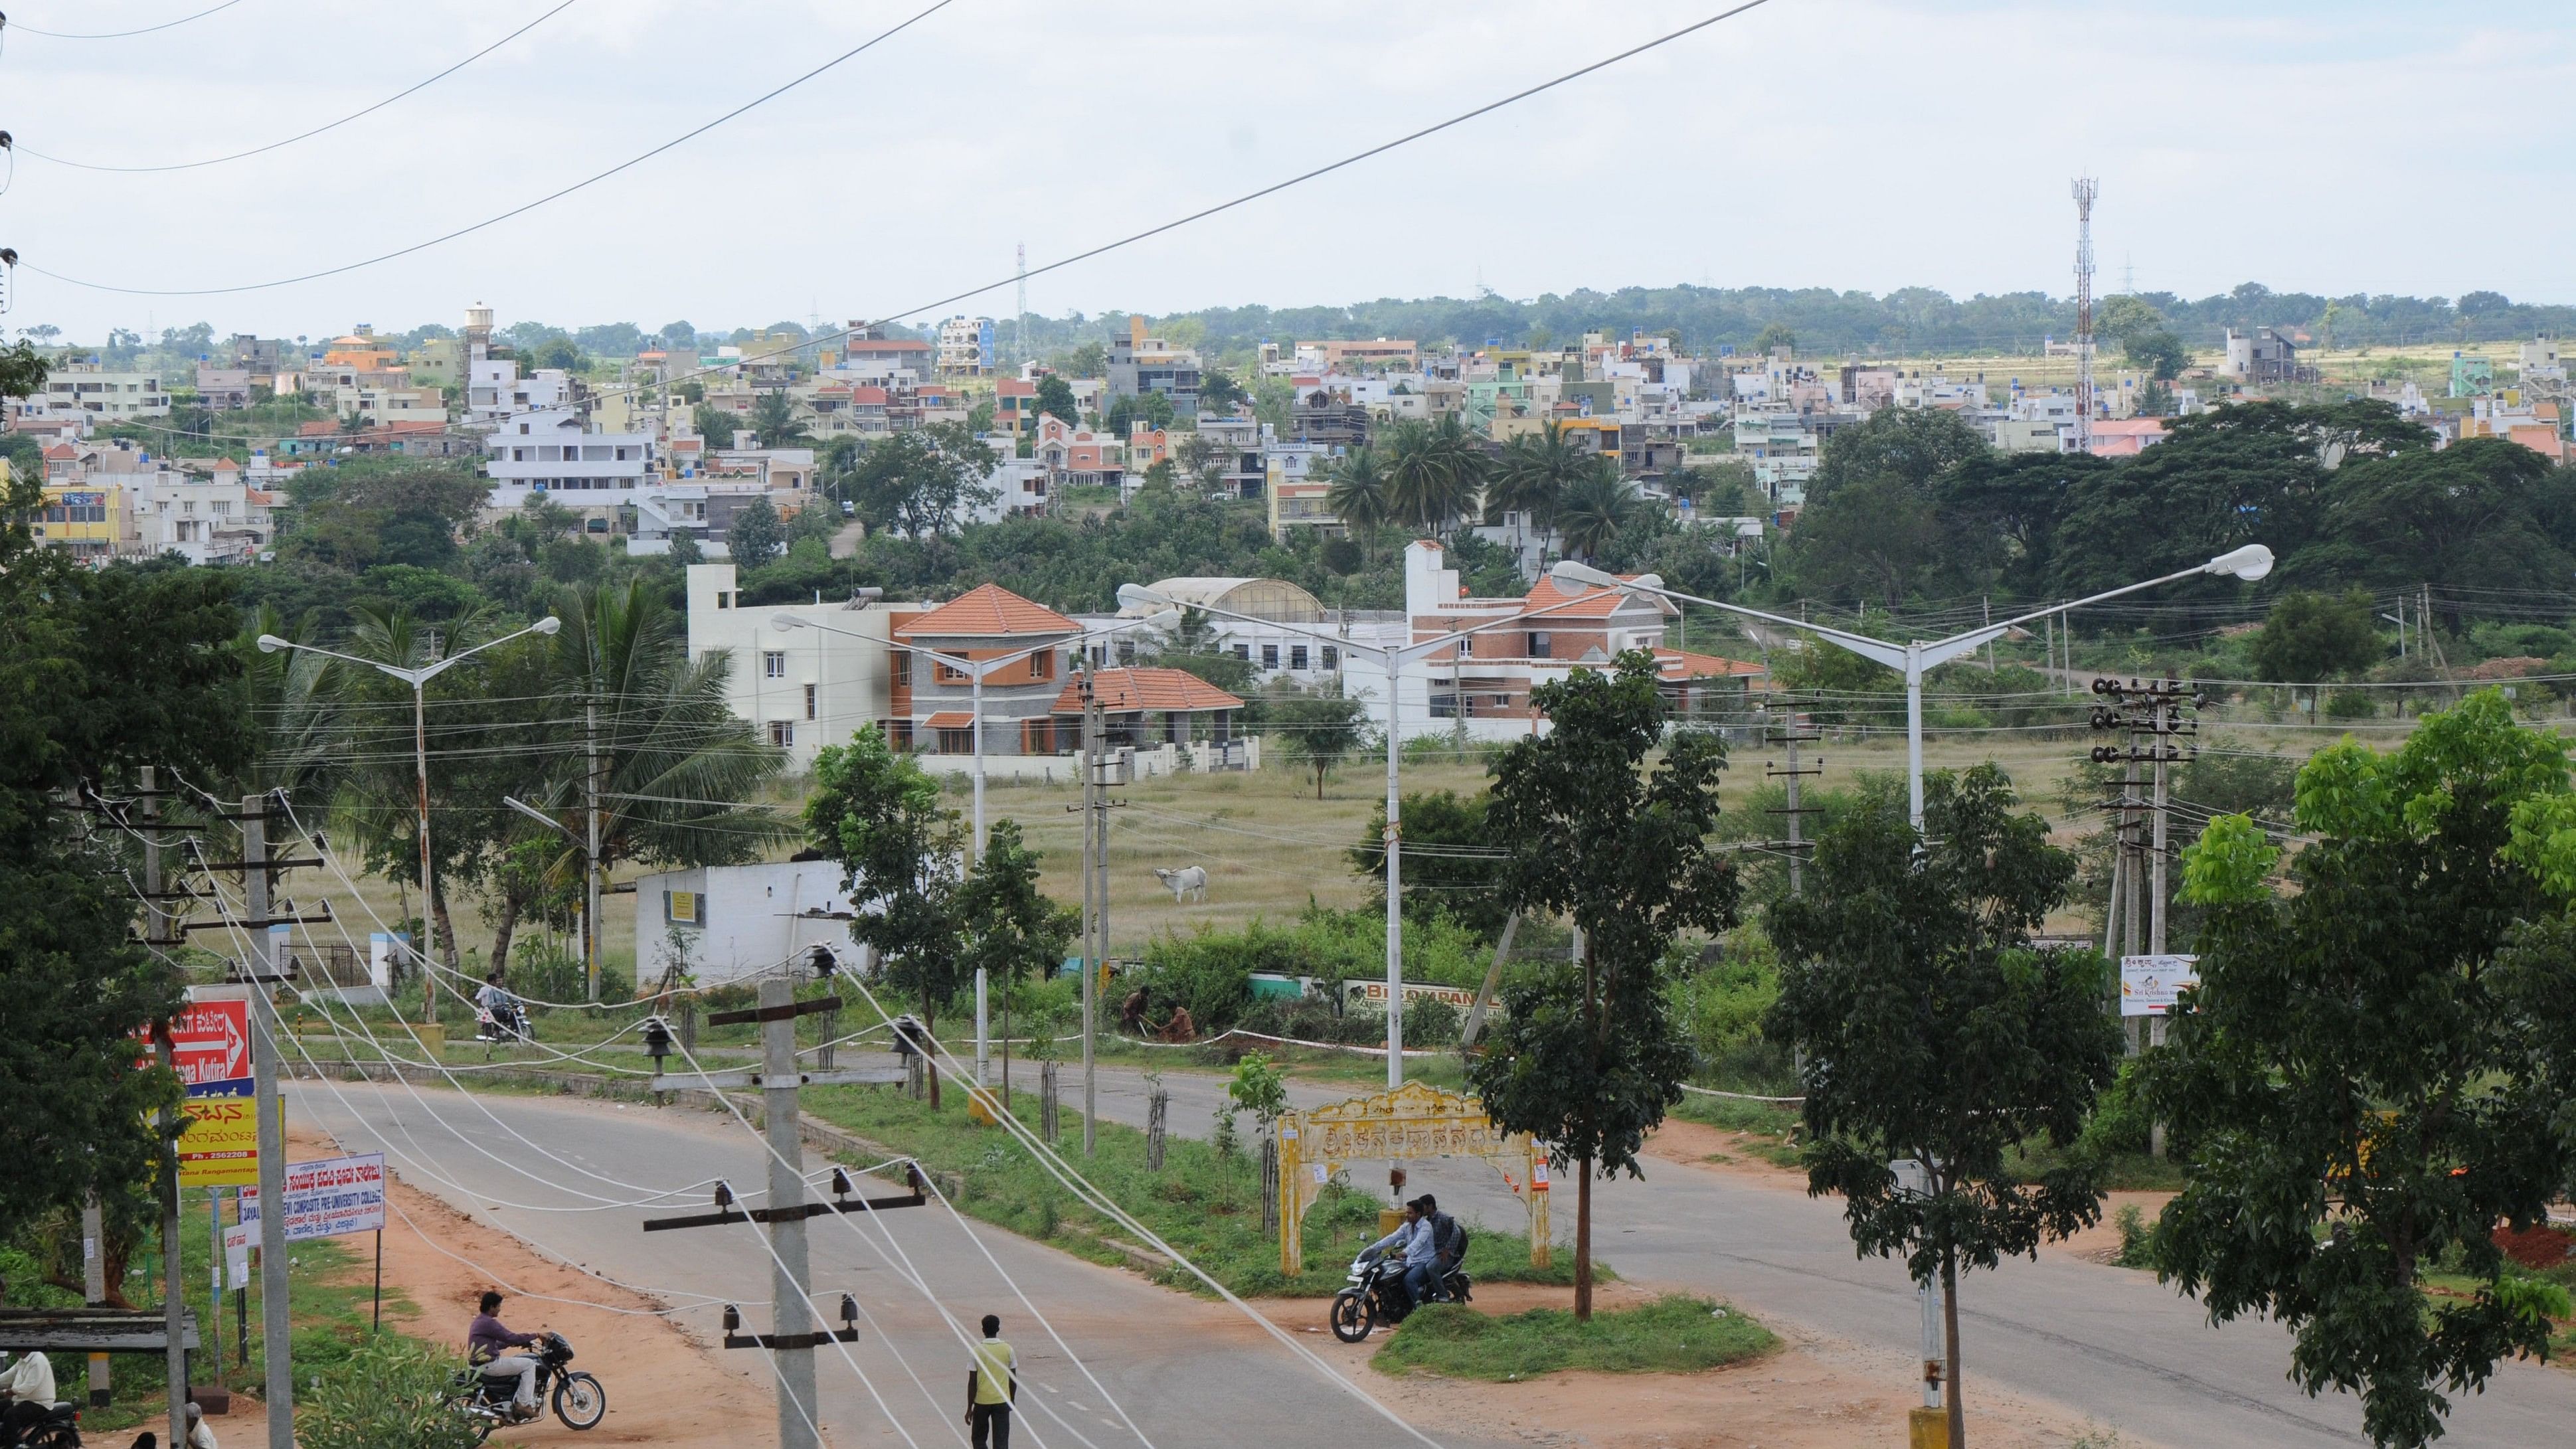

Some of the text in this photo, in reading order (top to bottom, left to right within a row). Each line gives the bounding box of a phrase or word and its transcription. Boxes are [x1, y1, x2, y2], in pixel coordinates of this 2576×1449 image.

[1438, 991, 1500, 1007] PANL
[199, 1057, 225, 1082] Kutira
[201, 1167, 258, 1175] Rangamantap
[293, 1197, 319, 1214] COMPOSITE
[321, 1192, 360, 1211] PRE-UNIVERSITY
[361, 1189, 381, 1205] COLLEGE
